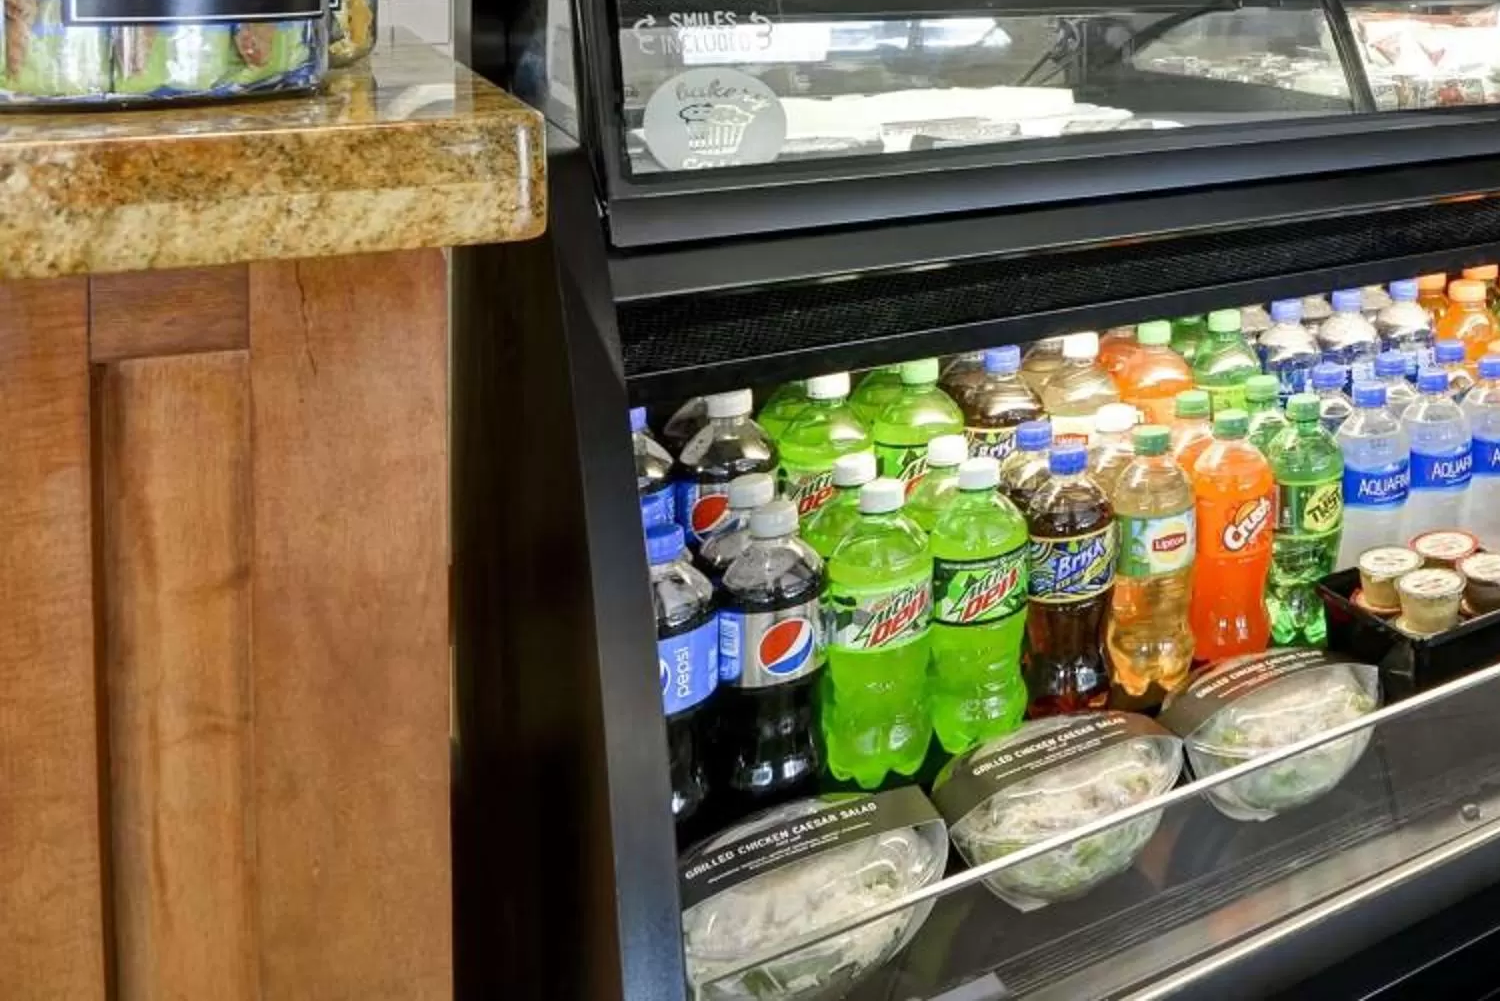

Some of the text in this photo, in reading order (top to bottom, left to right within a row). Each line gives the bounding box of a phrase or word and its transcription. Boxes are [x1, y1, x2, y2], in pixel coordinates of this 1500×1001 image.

[669, 10, 737, 29] SMILES
[1222, 496, 1271, 552] Crush
[674, 646, 691, 698] pepsi
[684, 851, 735, 880] GRILLED
[737, 829, 789, 854] CHICKEN
[792, 814, 838, 834] CAESAR
[840, 802, 877, 820] SALAD
